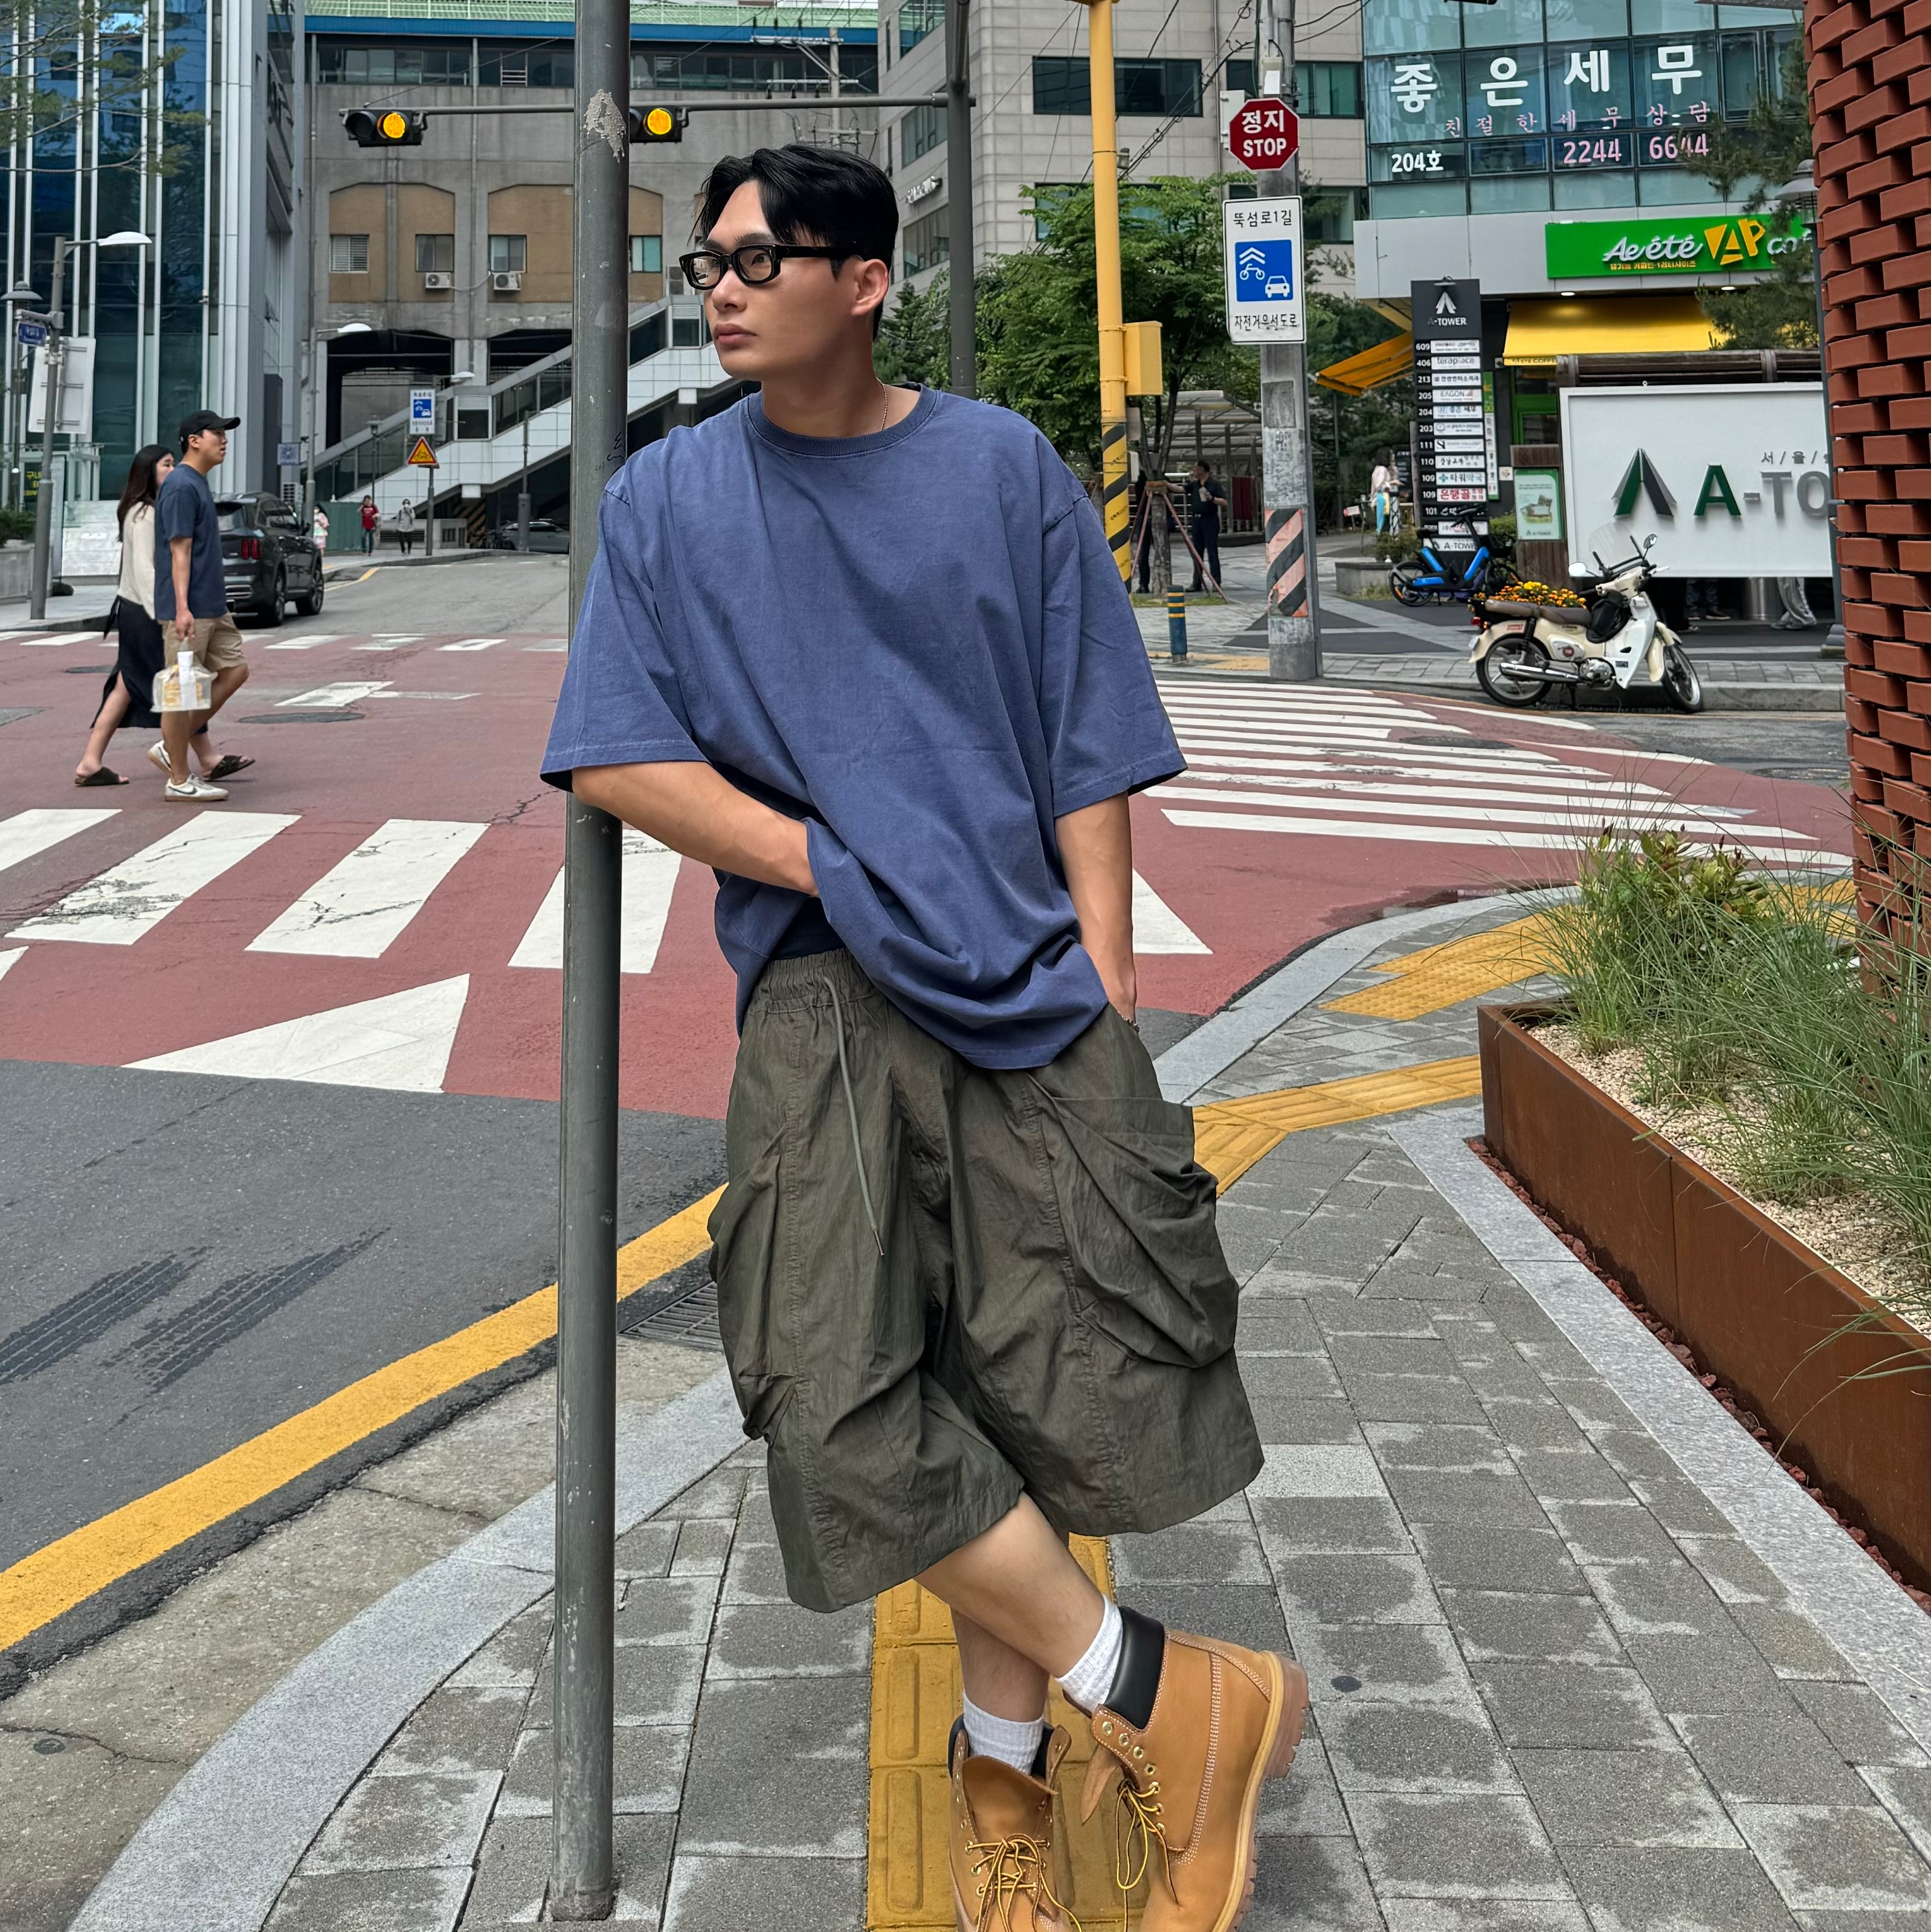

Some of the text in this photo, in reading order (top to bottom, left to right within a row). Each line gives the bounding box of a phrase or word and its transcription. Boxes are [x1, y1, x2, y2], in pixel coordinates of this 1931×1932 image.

[1242, 109, 1285, 134] 정지
[1243, 138, 1288, 158] STOP
[1562, 133, 1710, 165] 2244 6644
[1391, 149, 1444, 174] 204호
[1233, 209, 1292, 228] 뚝섬로1길
[1234, 313, 1298, 332] 자전거우선도로
[1426, 317, 1468, 326] A-TOWER
[1416, 343, 1430, 351] 609
[1417, 375, 1431, 384] 213
[1425, 507, 1437, 515] 101
